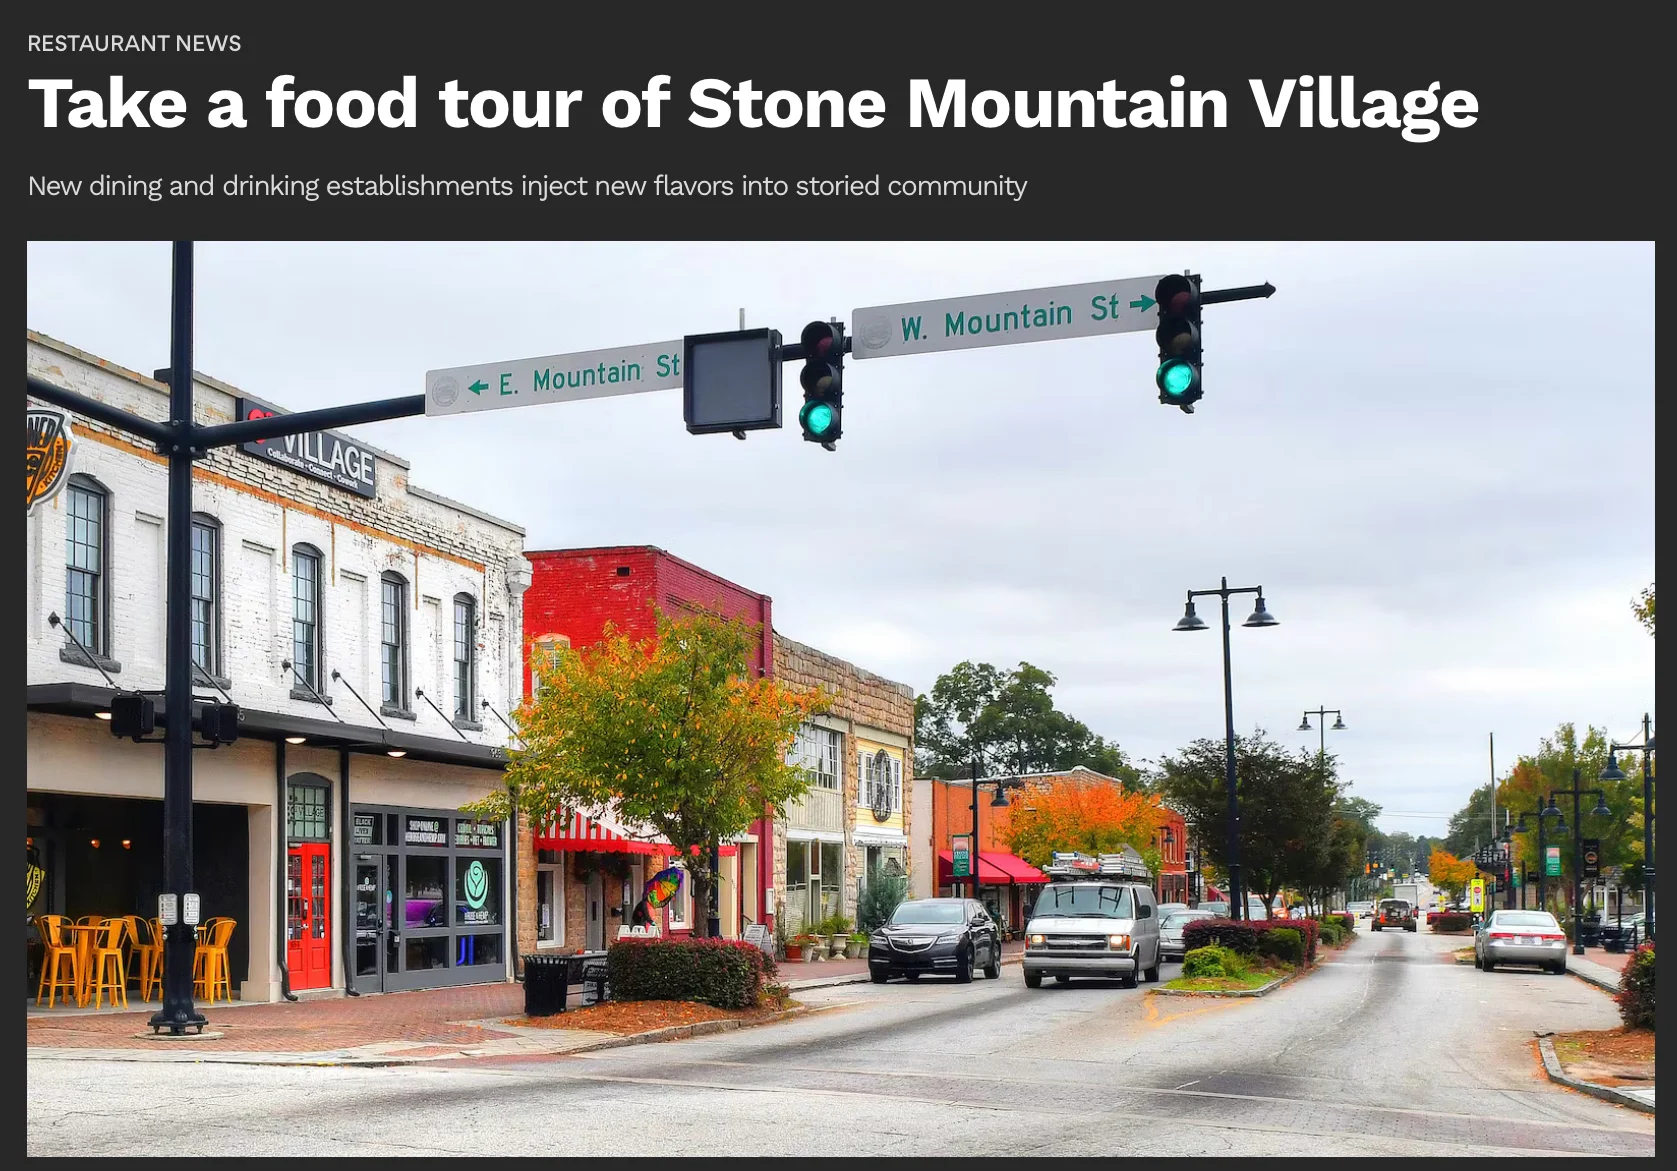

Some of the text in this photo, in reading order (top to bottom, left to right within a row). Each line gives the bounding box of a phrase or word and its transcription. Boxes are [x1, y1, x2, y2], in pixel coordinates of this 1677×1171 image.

[901, 293, 1119, 342] W. Mountain St
[499, 353, 680, 396] E. Mountain St
[267, 447, 359, 490] Collaborate Connect Cowork
[283, 431, 374, 486] VILLAGE
[355, 818, 372, 826] BLACK
